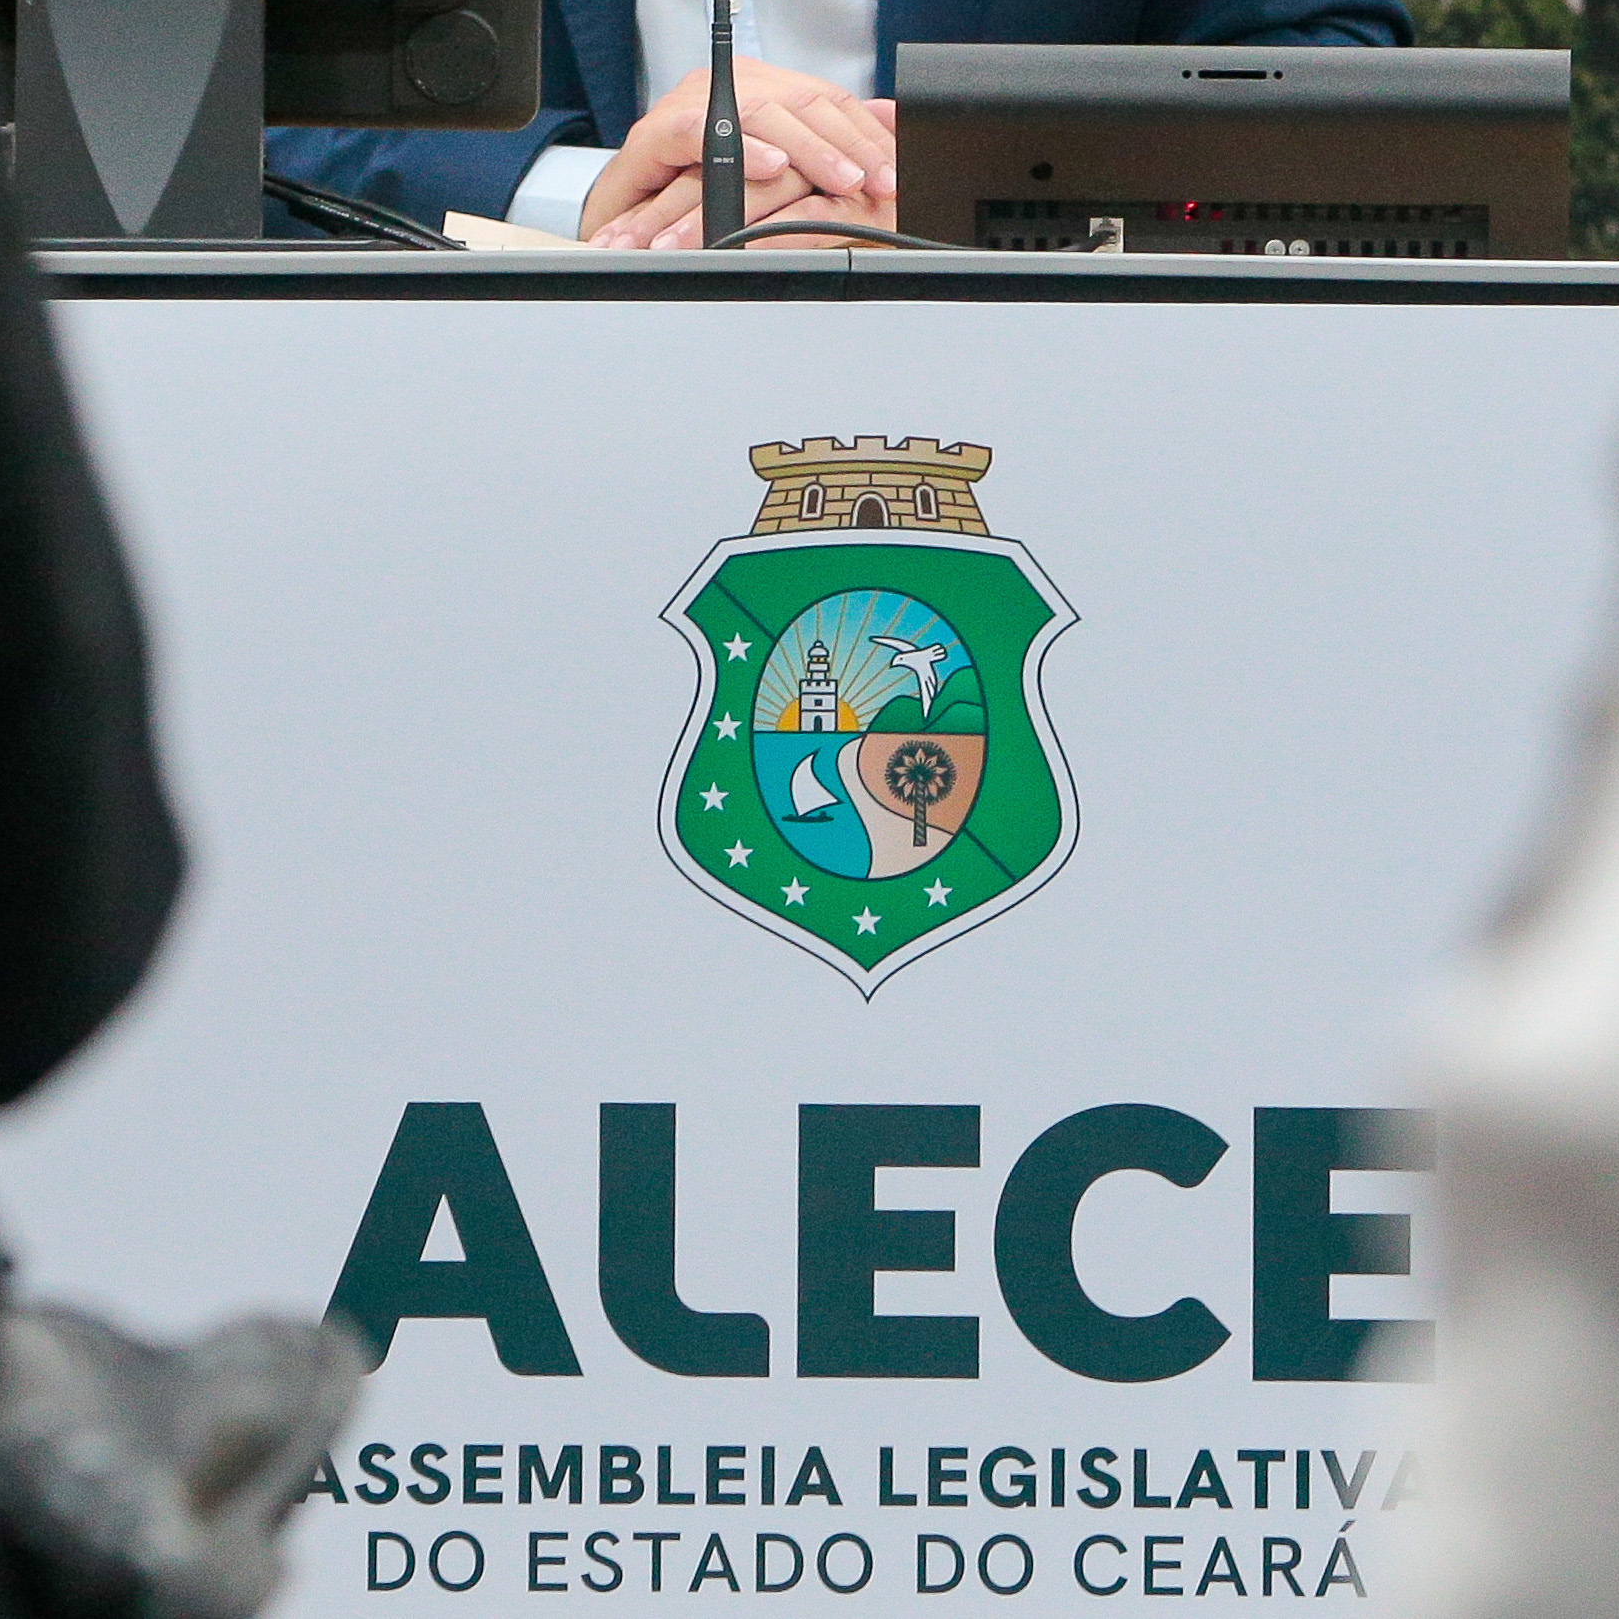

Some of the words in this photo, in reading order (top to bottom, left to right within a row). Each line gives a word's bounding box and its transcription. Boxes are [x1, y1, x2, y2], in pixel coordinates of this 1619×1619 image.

[320, 1101, 1437, 1383] ALECE
[296, 1442, 844, 1506] ASSEMBLEIA
[366, 1530, 486, 1593] DO
[527, 1531, 875, 1595] ESTADO
[915, 1533, 1035, 1596] DO
[1072, 1519, 1369, 1599] CEARÁ
